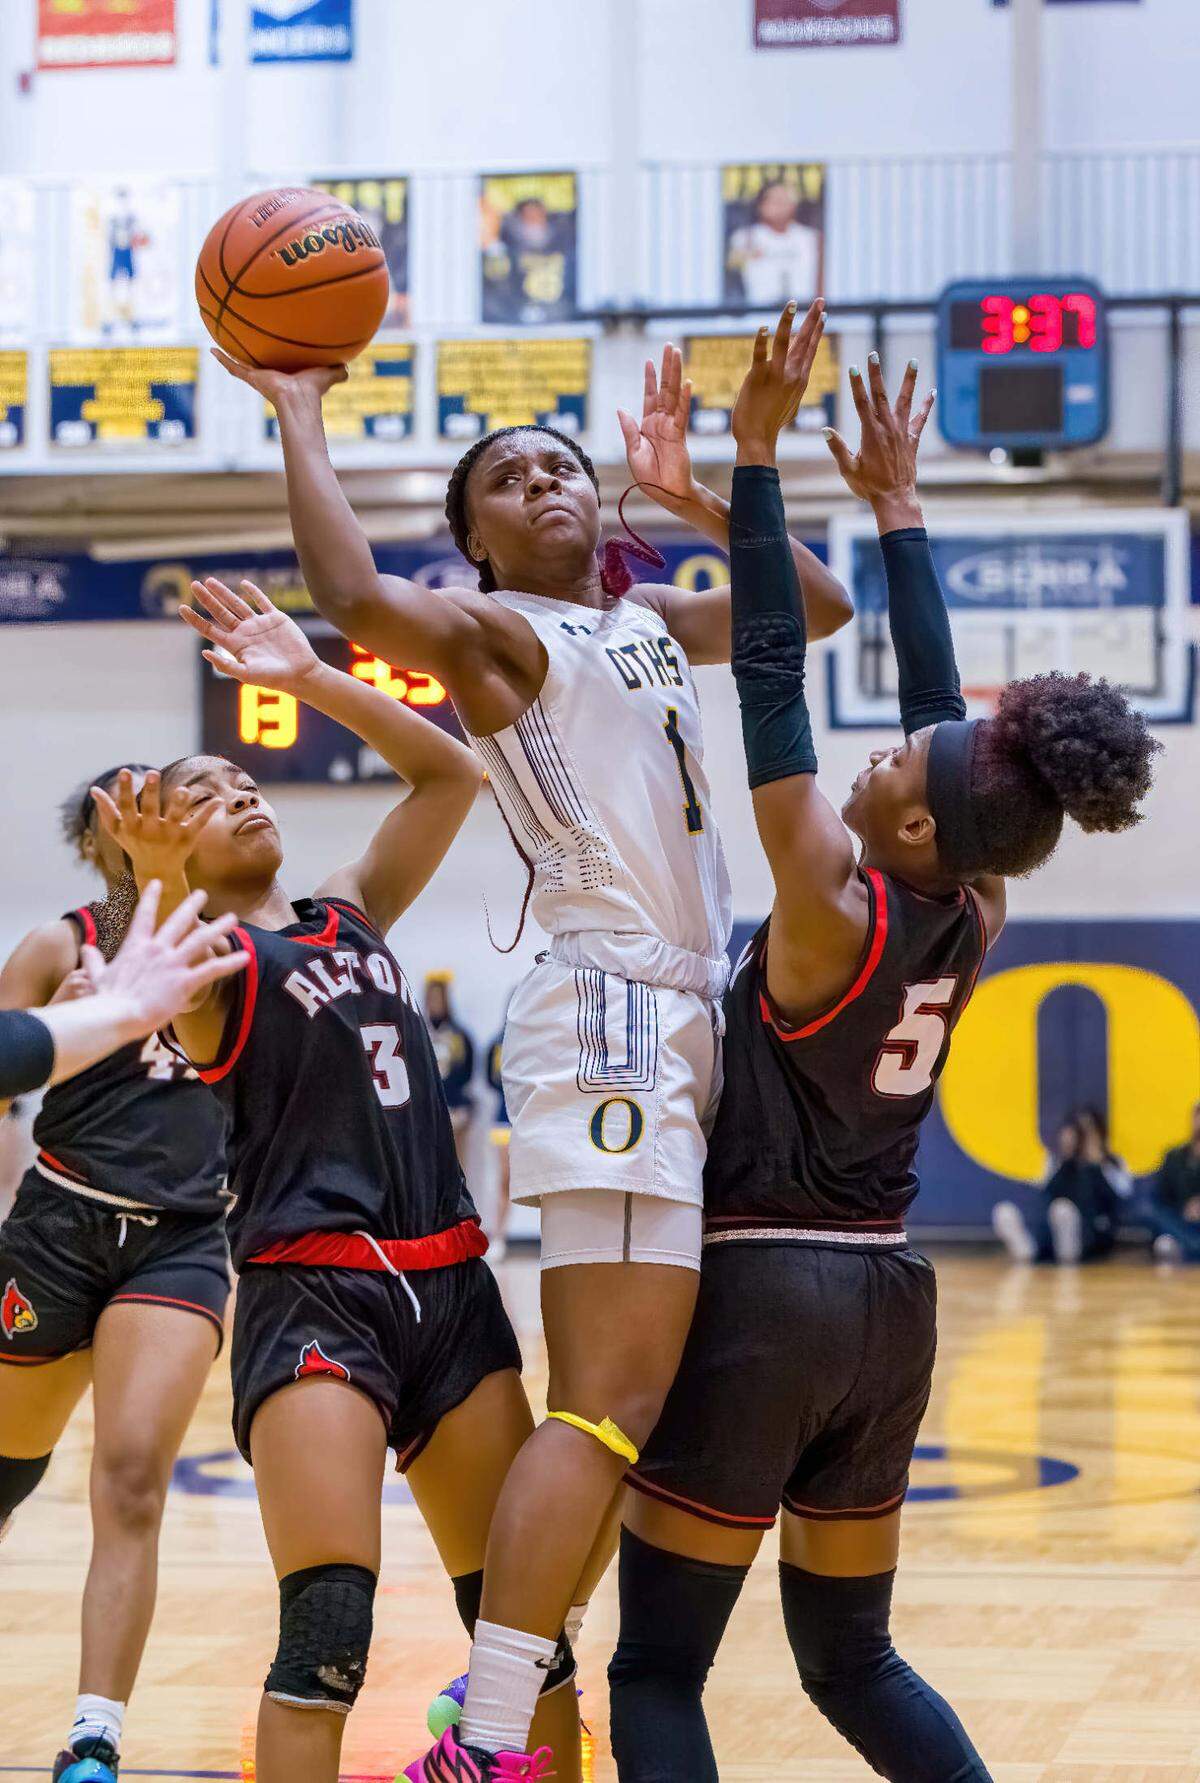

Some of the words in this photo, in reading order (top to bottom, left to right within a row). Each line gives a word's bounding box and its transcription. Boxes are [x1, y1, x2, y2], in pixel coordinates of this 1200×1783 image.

[274, 217, 382, 267] Wilson
[980, 293, 1097, 354] 3:37
[662, 706, 704, 836] 1
[359, 1023, 412, 1110] 3
[872, 974, 958, 1099] 5
[588, 1095, 645, 1154] O
